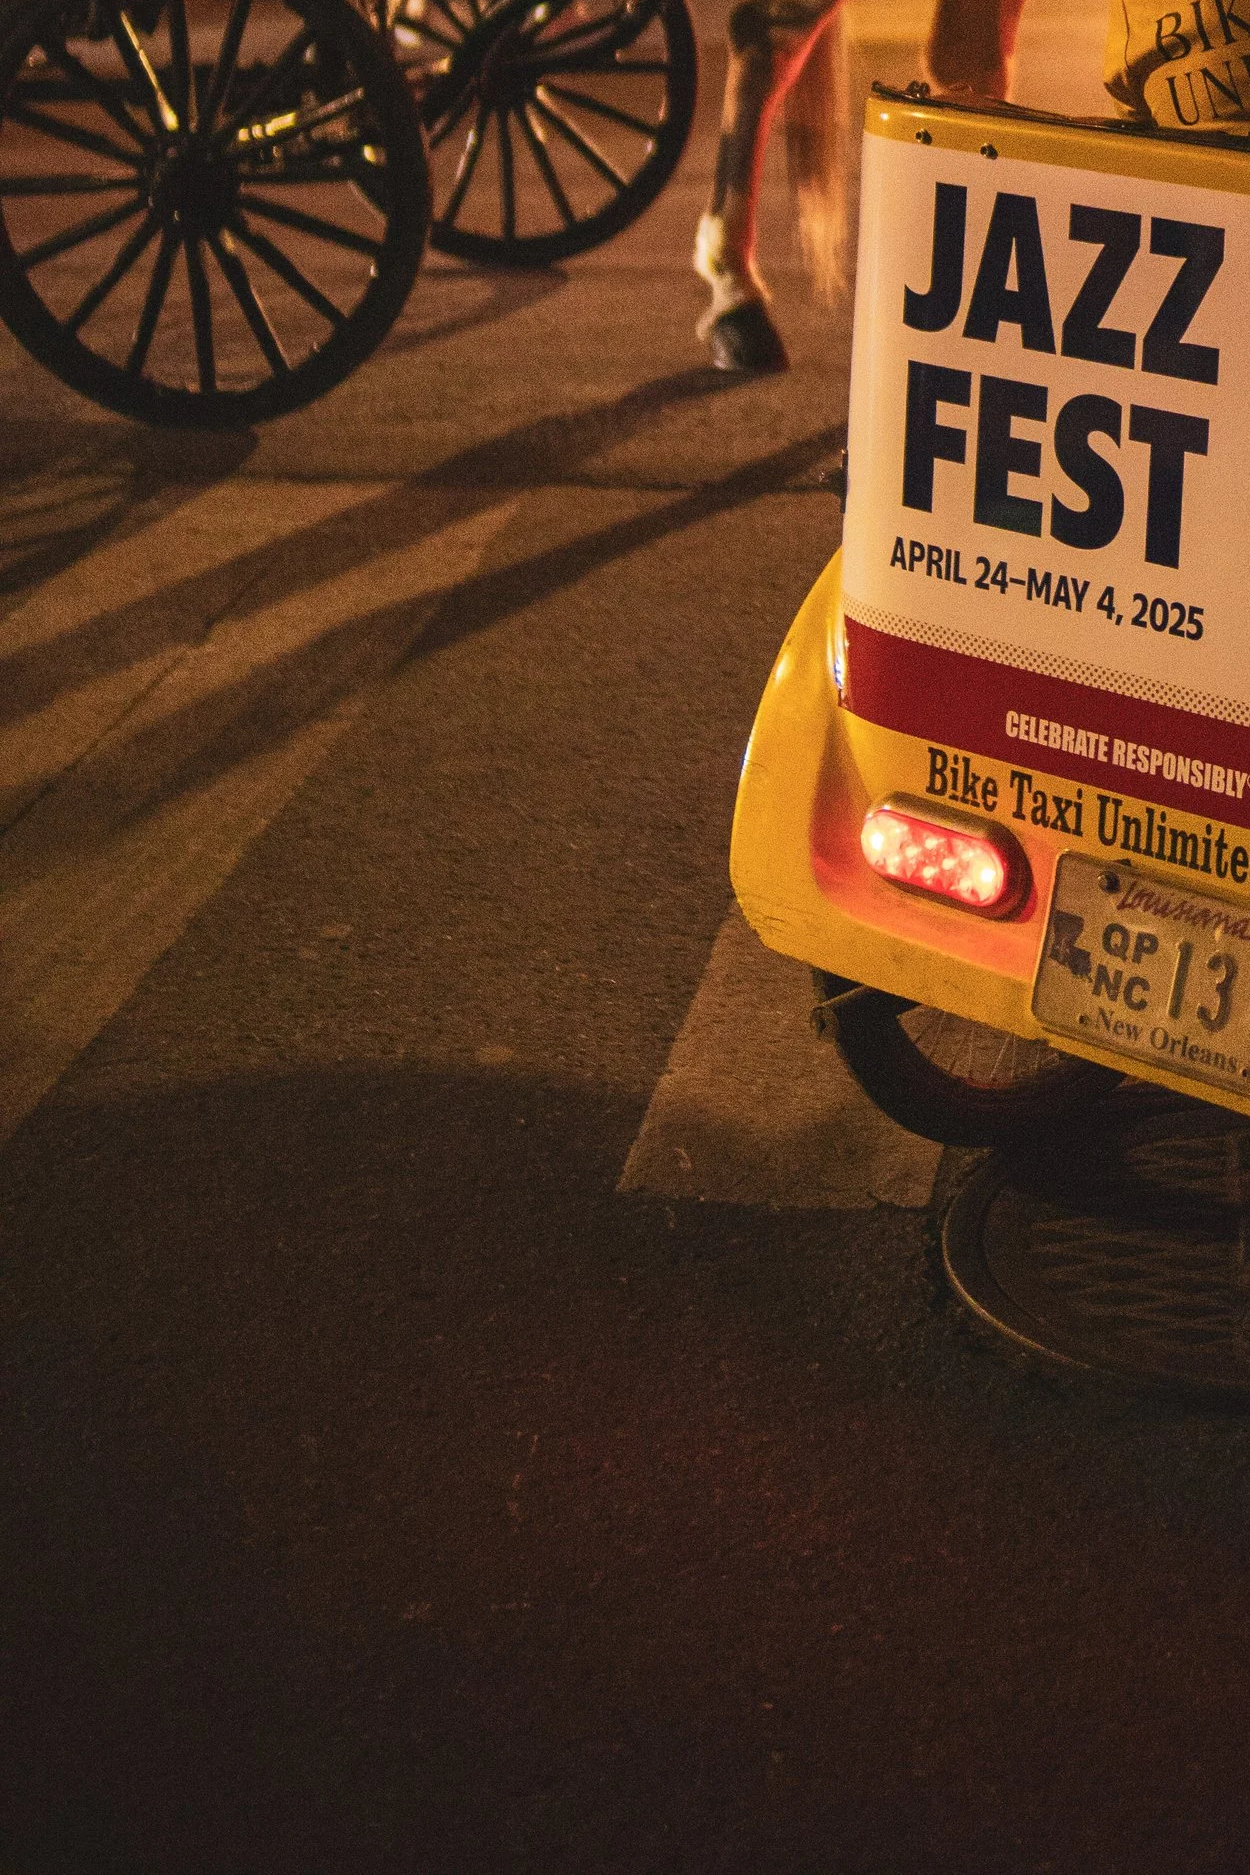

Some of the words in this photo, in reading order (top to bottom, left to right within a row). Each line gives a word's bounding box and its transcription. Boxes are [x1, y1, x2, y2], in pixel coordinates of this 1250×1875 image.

[902, 181, 1225, 385] JAZZ
[902, 359, 1210, 569] FEST
[890, 536, 967, 585] APRIL
[1097, 585, 1124, 624] 4,
[1131, 592, 1205, 641] 2025
[1005, 710, 1109, 763] CELEBRATE
[924, 746, 999, 812] Bike
[1009, 770, 1084, 837] Taxi
[1090, 969, 1151, 1012] NC
[1102, 922, 1159, 966] QP
[1167, 937, 1240, 1033] 13
[1094, 1008, 1142, 1043] New
[1148, 1022, 1240, 1076] Orleans
